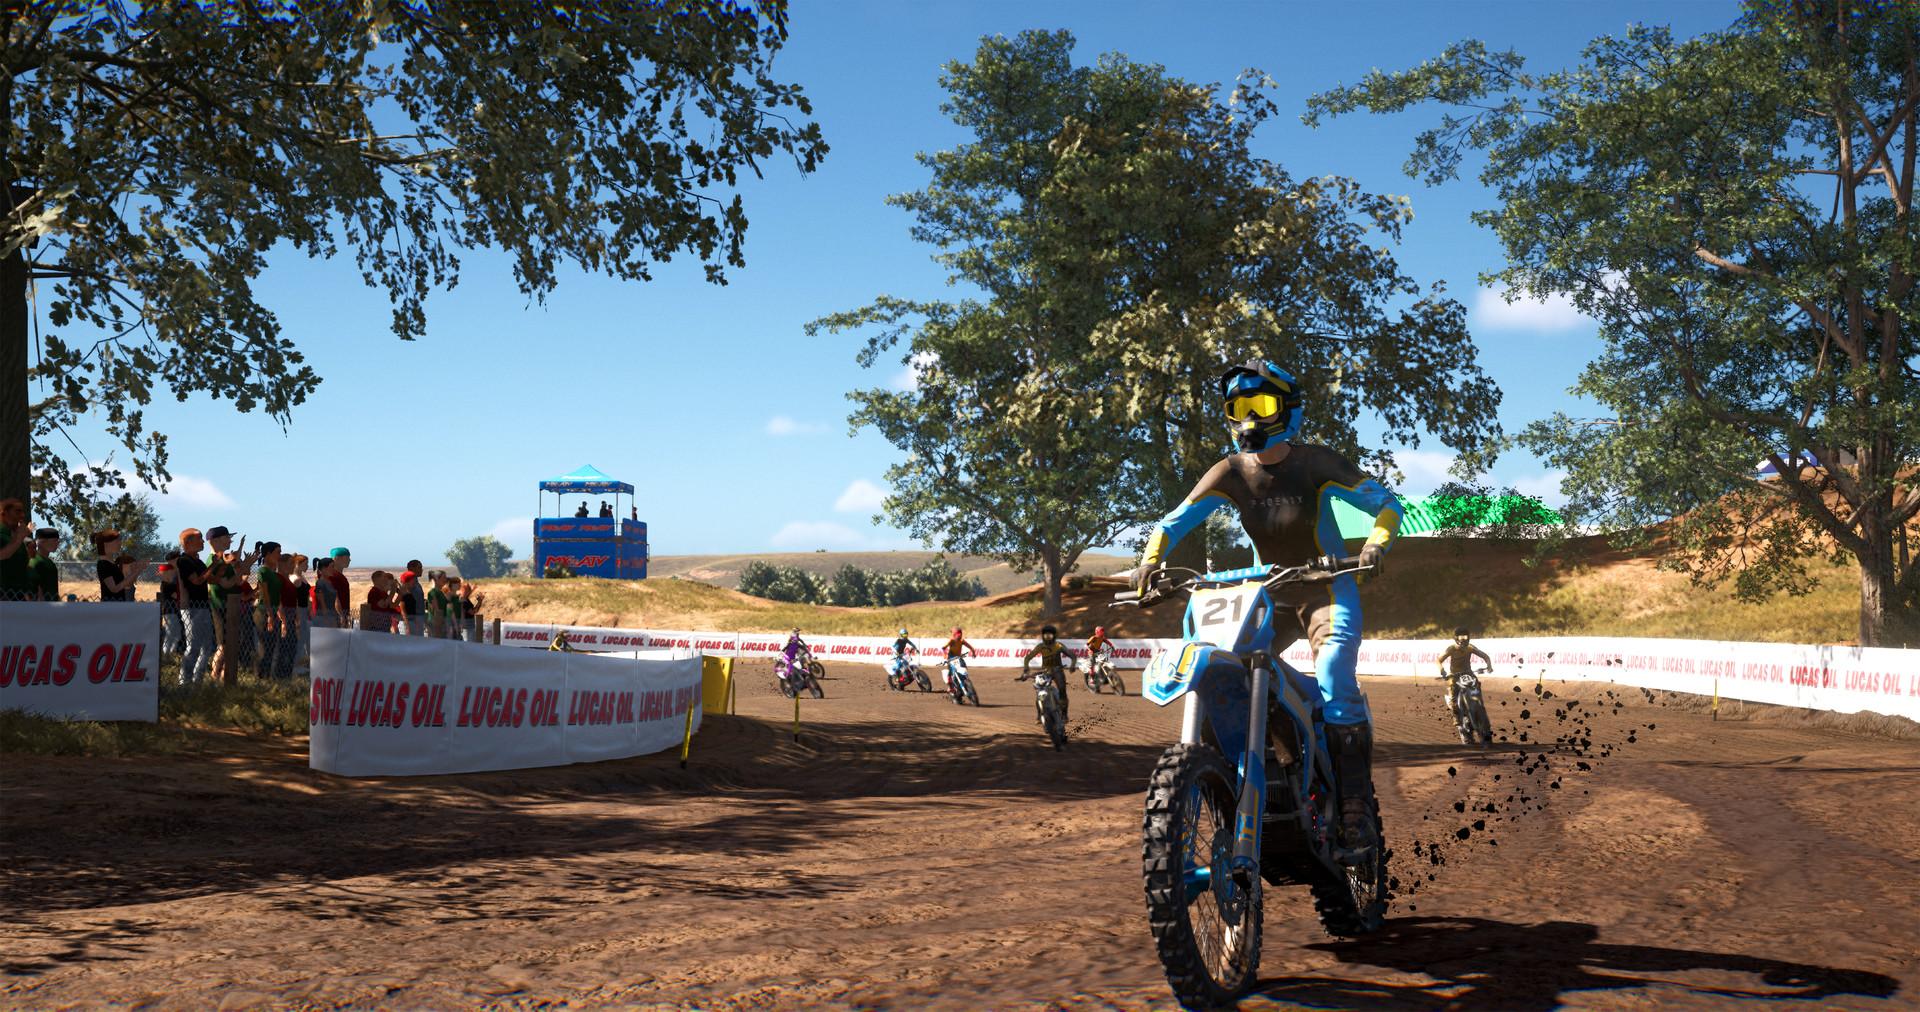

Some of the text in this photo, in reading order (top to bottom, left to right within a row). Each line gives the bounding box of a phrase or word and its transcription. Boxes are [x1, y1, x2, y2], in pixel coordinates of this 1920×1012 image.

[1201, 594, 1243, 627] 21
[504, 631, 534, 641] LUCAS
[534, 632, 549, 641] OIL
[583, 634, 598, 643] OIL
[601, 635, 645, 647] LUCAS OIL
[648, 638, 690, 649] LUCAS OIL
[695, 640, 735, 650] LUCAS OIL
[740, 642, 780, 652] LUCAS OIL
[813, 644, 826, 654] OIL
[830, 645, 872, 655] LUCAS OIL
[996, 648, 1010, 658] OIL
[1110, 648, 1138, 658] LUCAS
[1139, 649, 1152, 659] OIL
[1358, 652, 1370, 662] OIL
[0, 642, 148, 688] UCAS OIL
[1626, 655, 1658, 671] LUCAS OIL
[1662, 656, 1696, 674] LUCAS OIL
[1700, 659, 1737, 678] LUCAS OIL
[1742, 662, 1784, 683] LUCAS OIL
[1790, 665, 1838, 689] LUCAS OIL
[1844, 670, 1880, 693] LUCAS
[1882, 672, 1902, 695] OIL
[346, 679, 447, 729] LUCAS OIL
[456, 685, 560, 729] LUCAS OIL
[567, 689, 634, 726] LUCAS OIL
[638, 689, 663, 722] LUCAS
